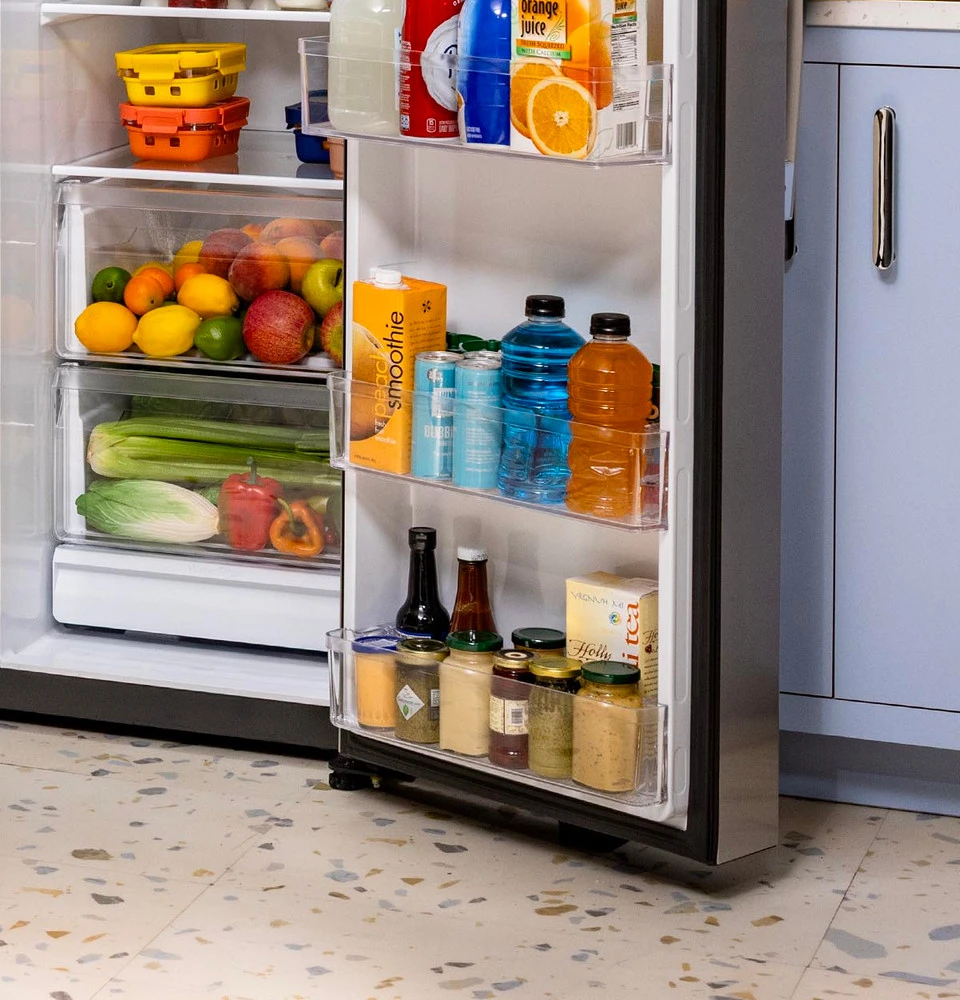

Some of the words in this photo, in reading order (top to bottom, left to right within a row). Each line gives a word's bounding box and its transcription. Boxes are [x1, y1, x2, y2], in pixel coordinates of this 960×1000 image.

[521, 0, 559, 19] orange
[520, 15, 546, 37] juice
[383, 311, 405, 410] smoothie
[625, 602, 639, 645] tea
